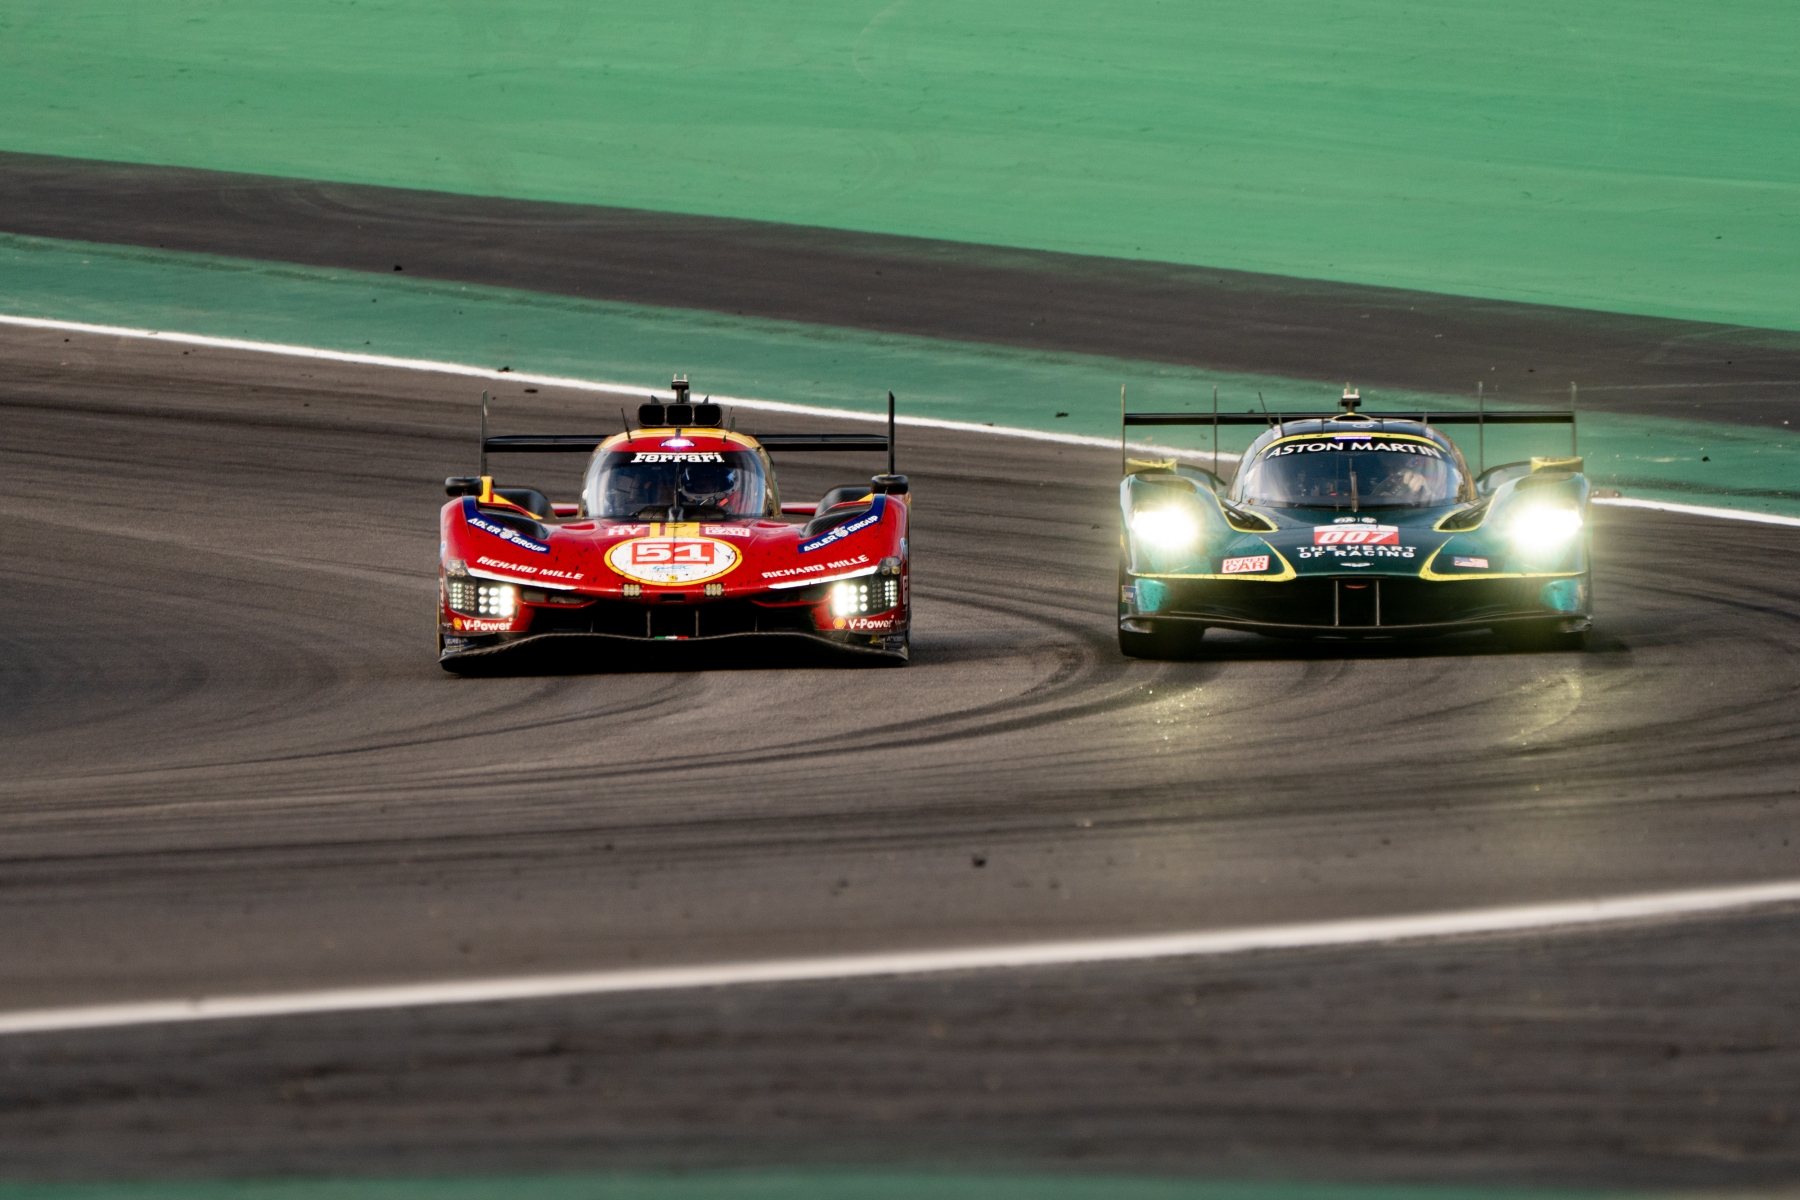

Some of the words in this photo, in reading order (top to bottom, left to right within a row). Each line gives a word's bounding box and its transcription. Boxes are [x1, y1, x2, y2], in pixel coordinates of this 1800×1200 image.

[630, 452, 725, 463] Ferrari
[1266, 442, 1344, 459] ASTON
[1351, 442, 1442, 459] MARTIN
[467, 518, 501, 533] ADLER
[511, 536, 547, 552] GROUP
[803, 534, 838, 552] ADLER
[847, 515, 879, 532] GROUP
[1317, 531, 1395, 544] 007
[636, 543, 711, 562] 51
[1297, 545, 1337, 553] THE
[1346, 545, 1417, 553] HEART
[1334, 550, 1415, 558] RACING
[477, 556, 538, 573] RICHARD
[539, 568, 584, 580] MILLE
[761, 563, 825, 579] RICHARD
[826, 554, 870, 569] MILLE
[1225, 556, 1266, 565] HYPER
[1225, 560, 1265, 572] CAR
